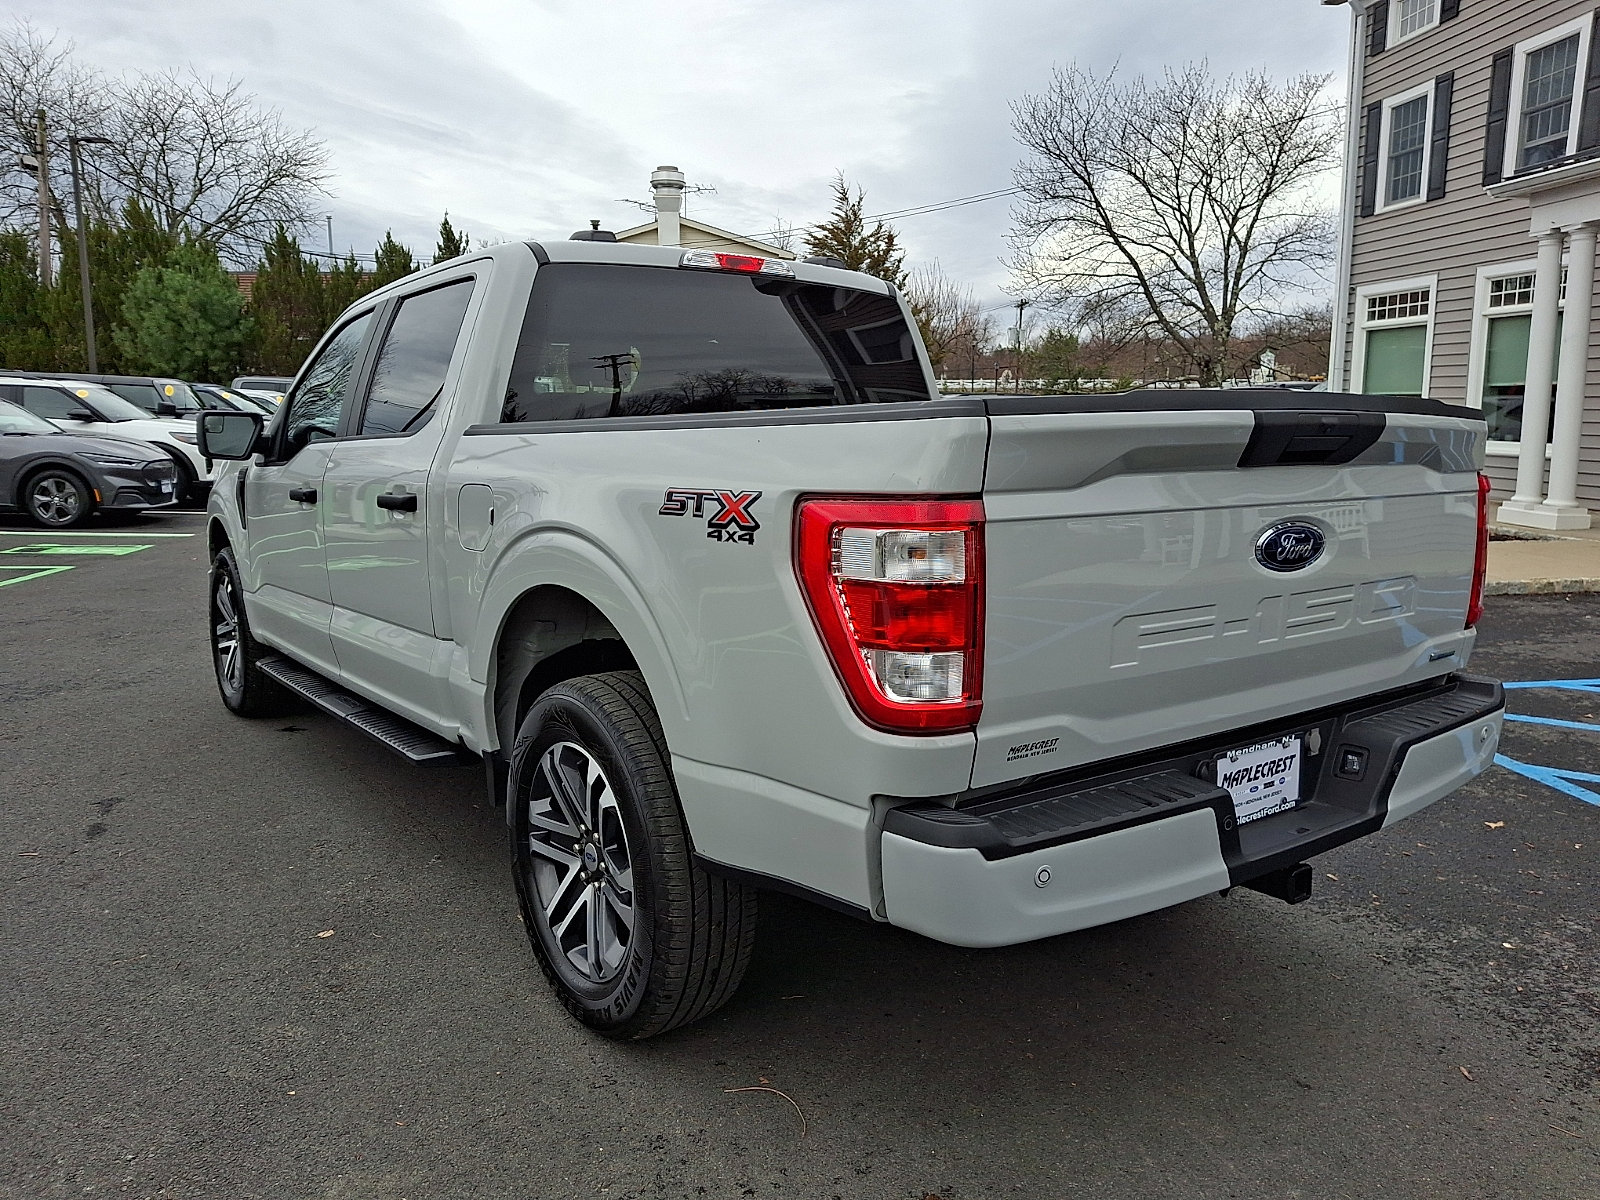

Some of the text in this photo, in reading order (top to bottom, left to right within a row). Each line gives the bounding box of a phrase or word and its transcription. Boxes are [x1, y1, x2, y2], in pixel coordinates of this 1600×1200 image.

[659, 487, 762, 532] STX
[1277, 533, 1314, 561] Ford
[1110, 574, 1417, 668] F-150
[1007, 737, 1060, 756] MAPLECREST
[1281, 734, 1295, 744] NJ
[1221, 754, 1297, 789] MAPLECREST
